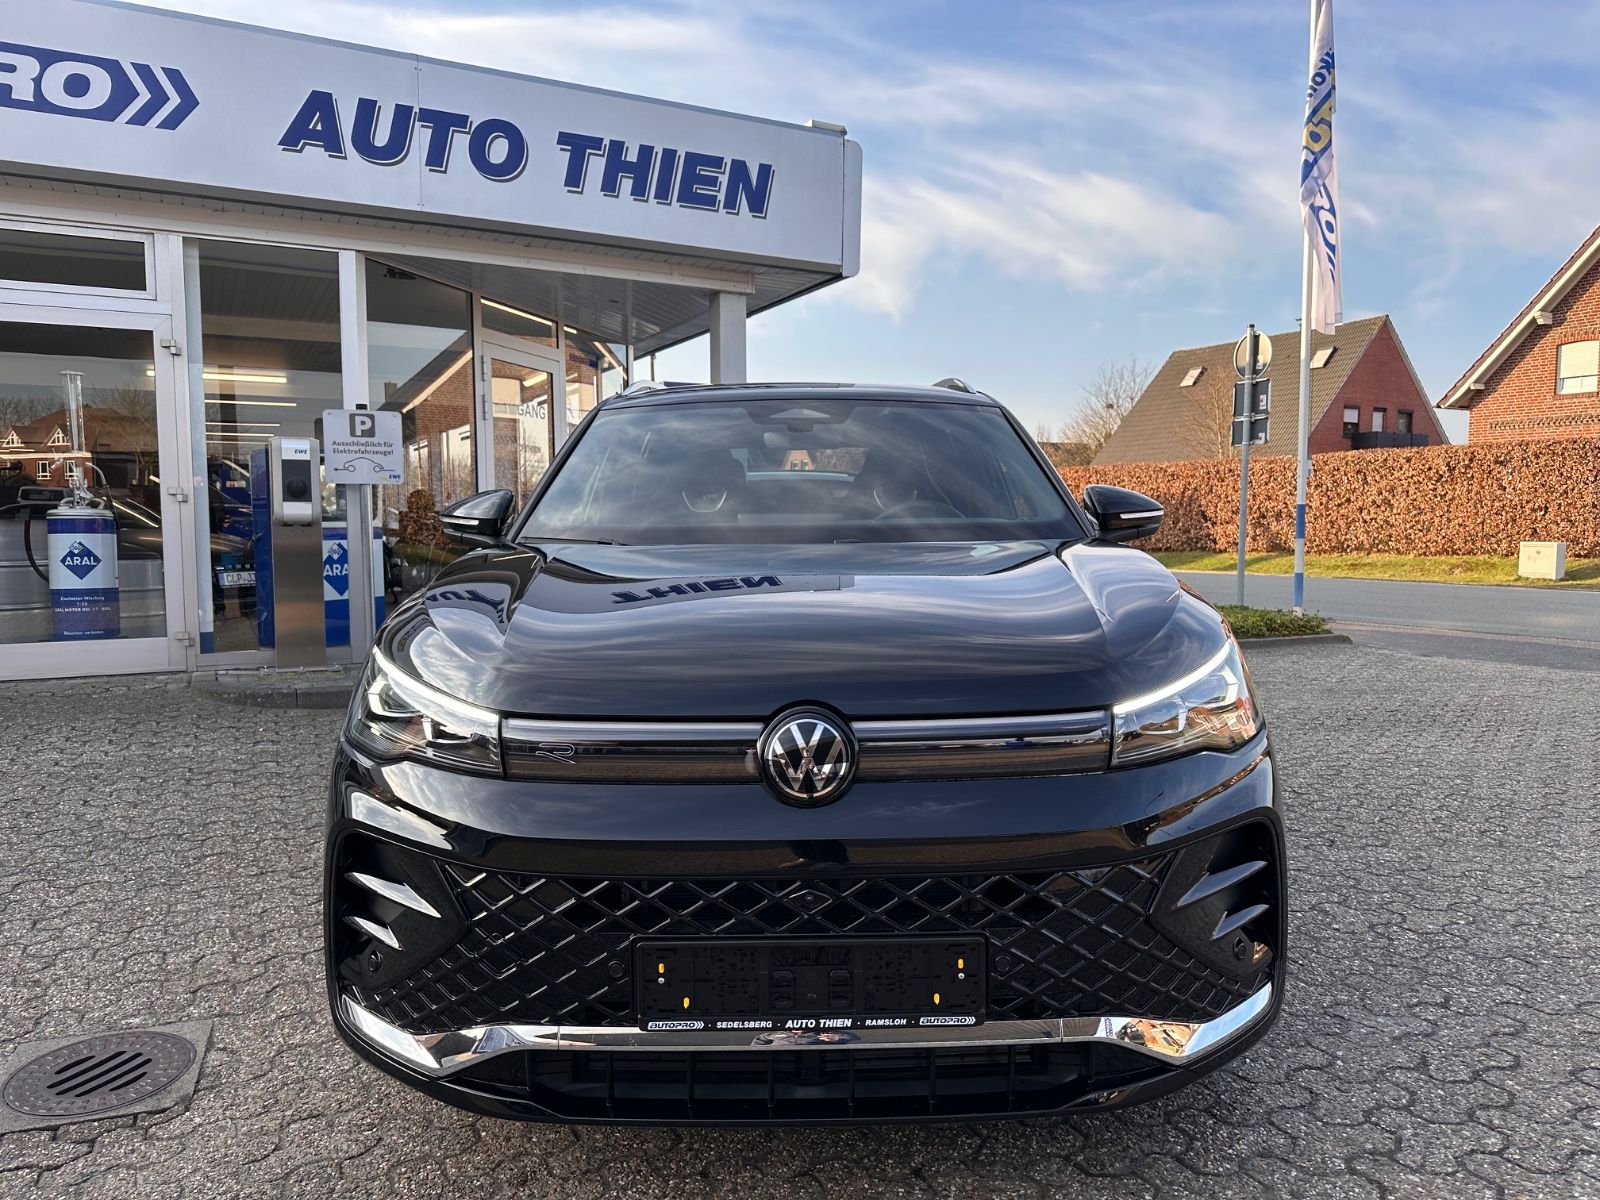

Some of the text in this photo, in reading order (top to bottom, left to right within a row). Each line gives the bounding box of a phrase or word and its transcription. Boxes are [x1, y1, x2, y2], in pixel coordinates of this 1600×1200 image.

[278, 90, 775, 219] AUTO THIEN
[518, 405, 546, 420] GANG
[355, 415, 372, 436] P
[65, 557, 98, 566] ARAL
[323, 563, 348, 577] ARA
[716, 1021, 773, 1029] SEDELSBERG
[785, 1020, 816, 1028] AUTO
[819, 1019, 852, 1028] THIEN
